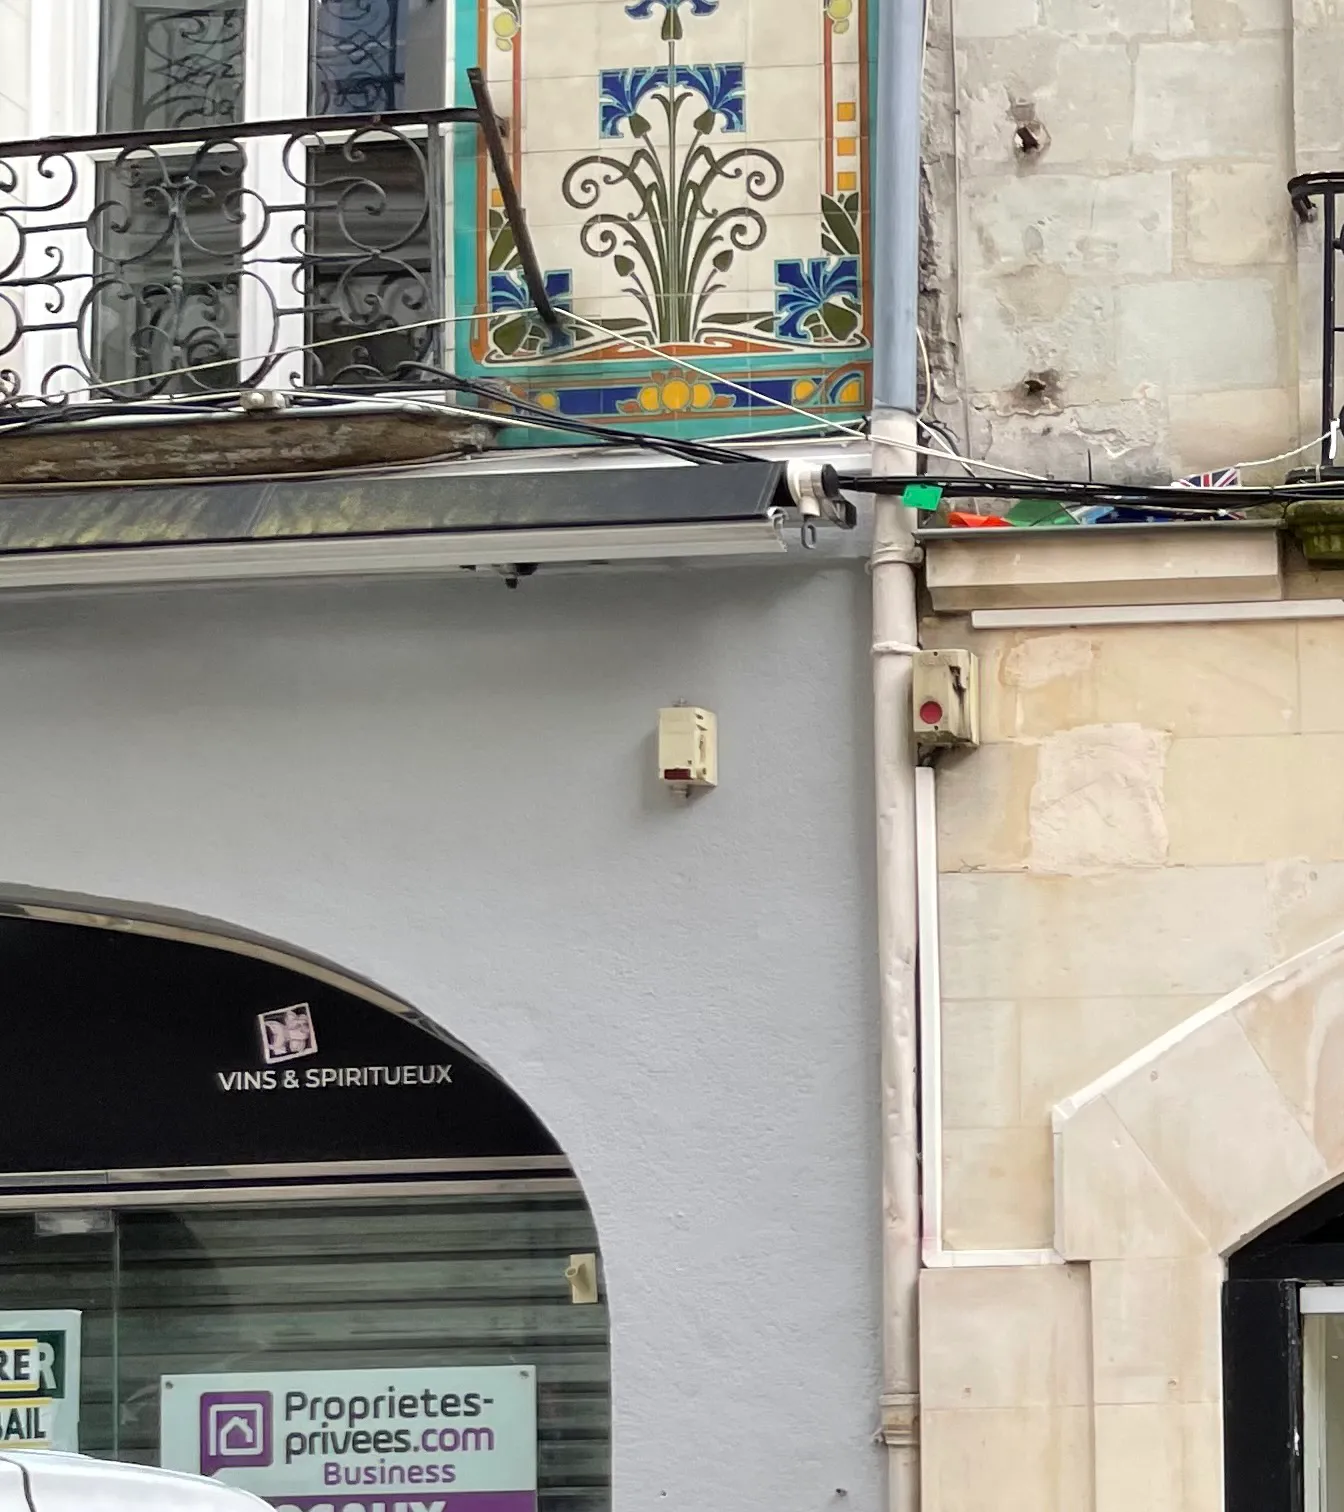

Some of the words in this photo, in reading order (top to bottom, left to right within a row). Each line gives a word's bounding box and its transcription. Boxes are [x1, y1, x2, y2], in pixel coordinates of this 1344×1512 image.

[218, 1070, 277, 1091] VINS
[283, 1069, 300, 1089] &
[305, 1063, 453, 1089] SPIRITUEUX
[0, 1407, 46, 1441] AIL
[285, 1386, 494, 1428] Proprietes-
[285, 1422, 495, 1465] privees.com
[323, 1458, 456, 1486] Business
